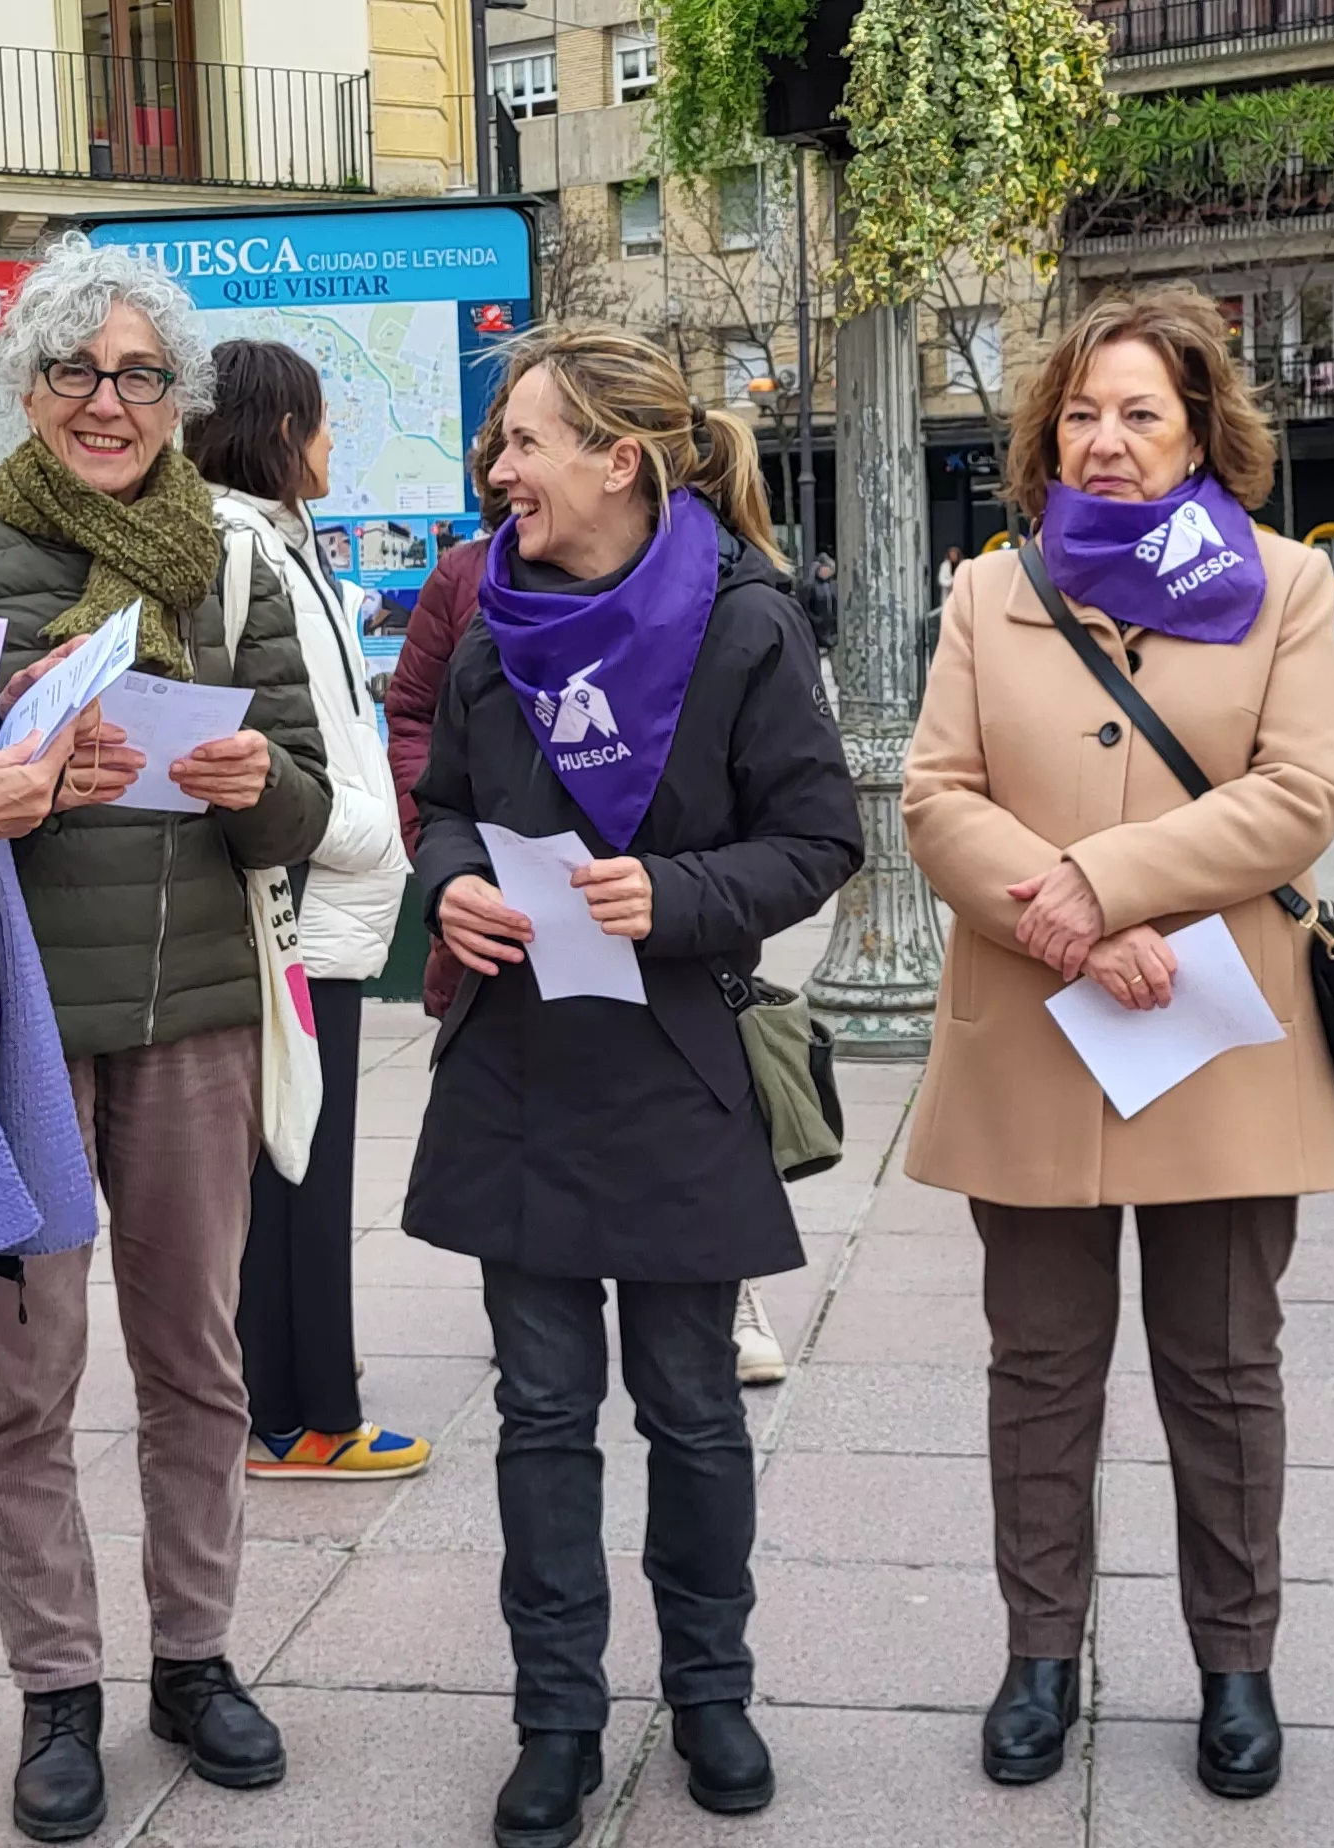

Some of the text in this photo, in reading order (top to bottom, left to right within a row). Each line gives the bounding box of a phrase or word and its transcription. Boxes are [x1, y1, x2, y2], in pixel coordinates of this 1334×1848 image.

[308, 252, 378, 272] CIUDAD
[382, 250, 407, 269] DE
[411, 247, 498, 269] LEYENDA
[223, 273, 390, 304] QUÉ VISITAR
[557, 741, 632, 772] HUESCA
